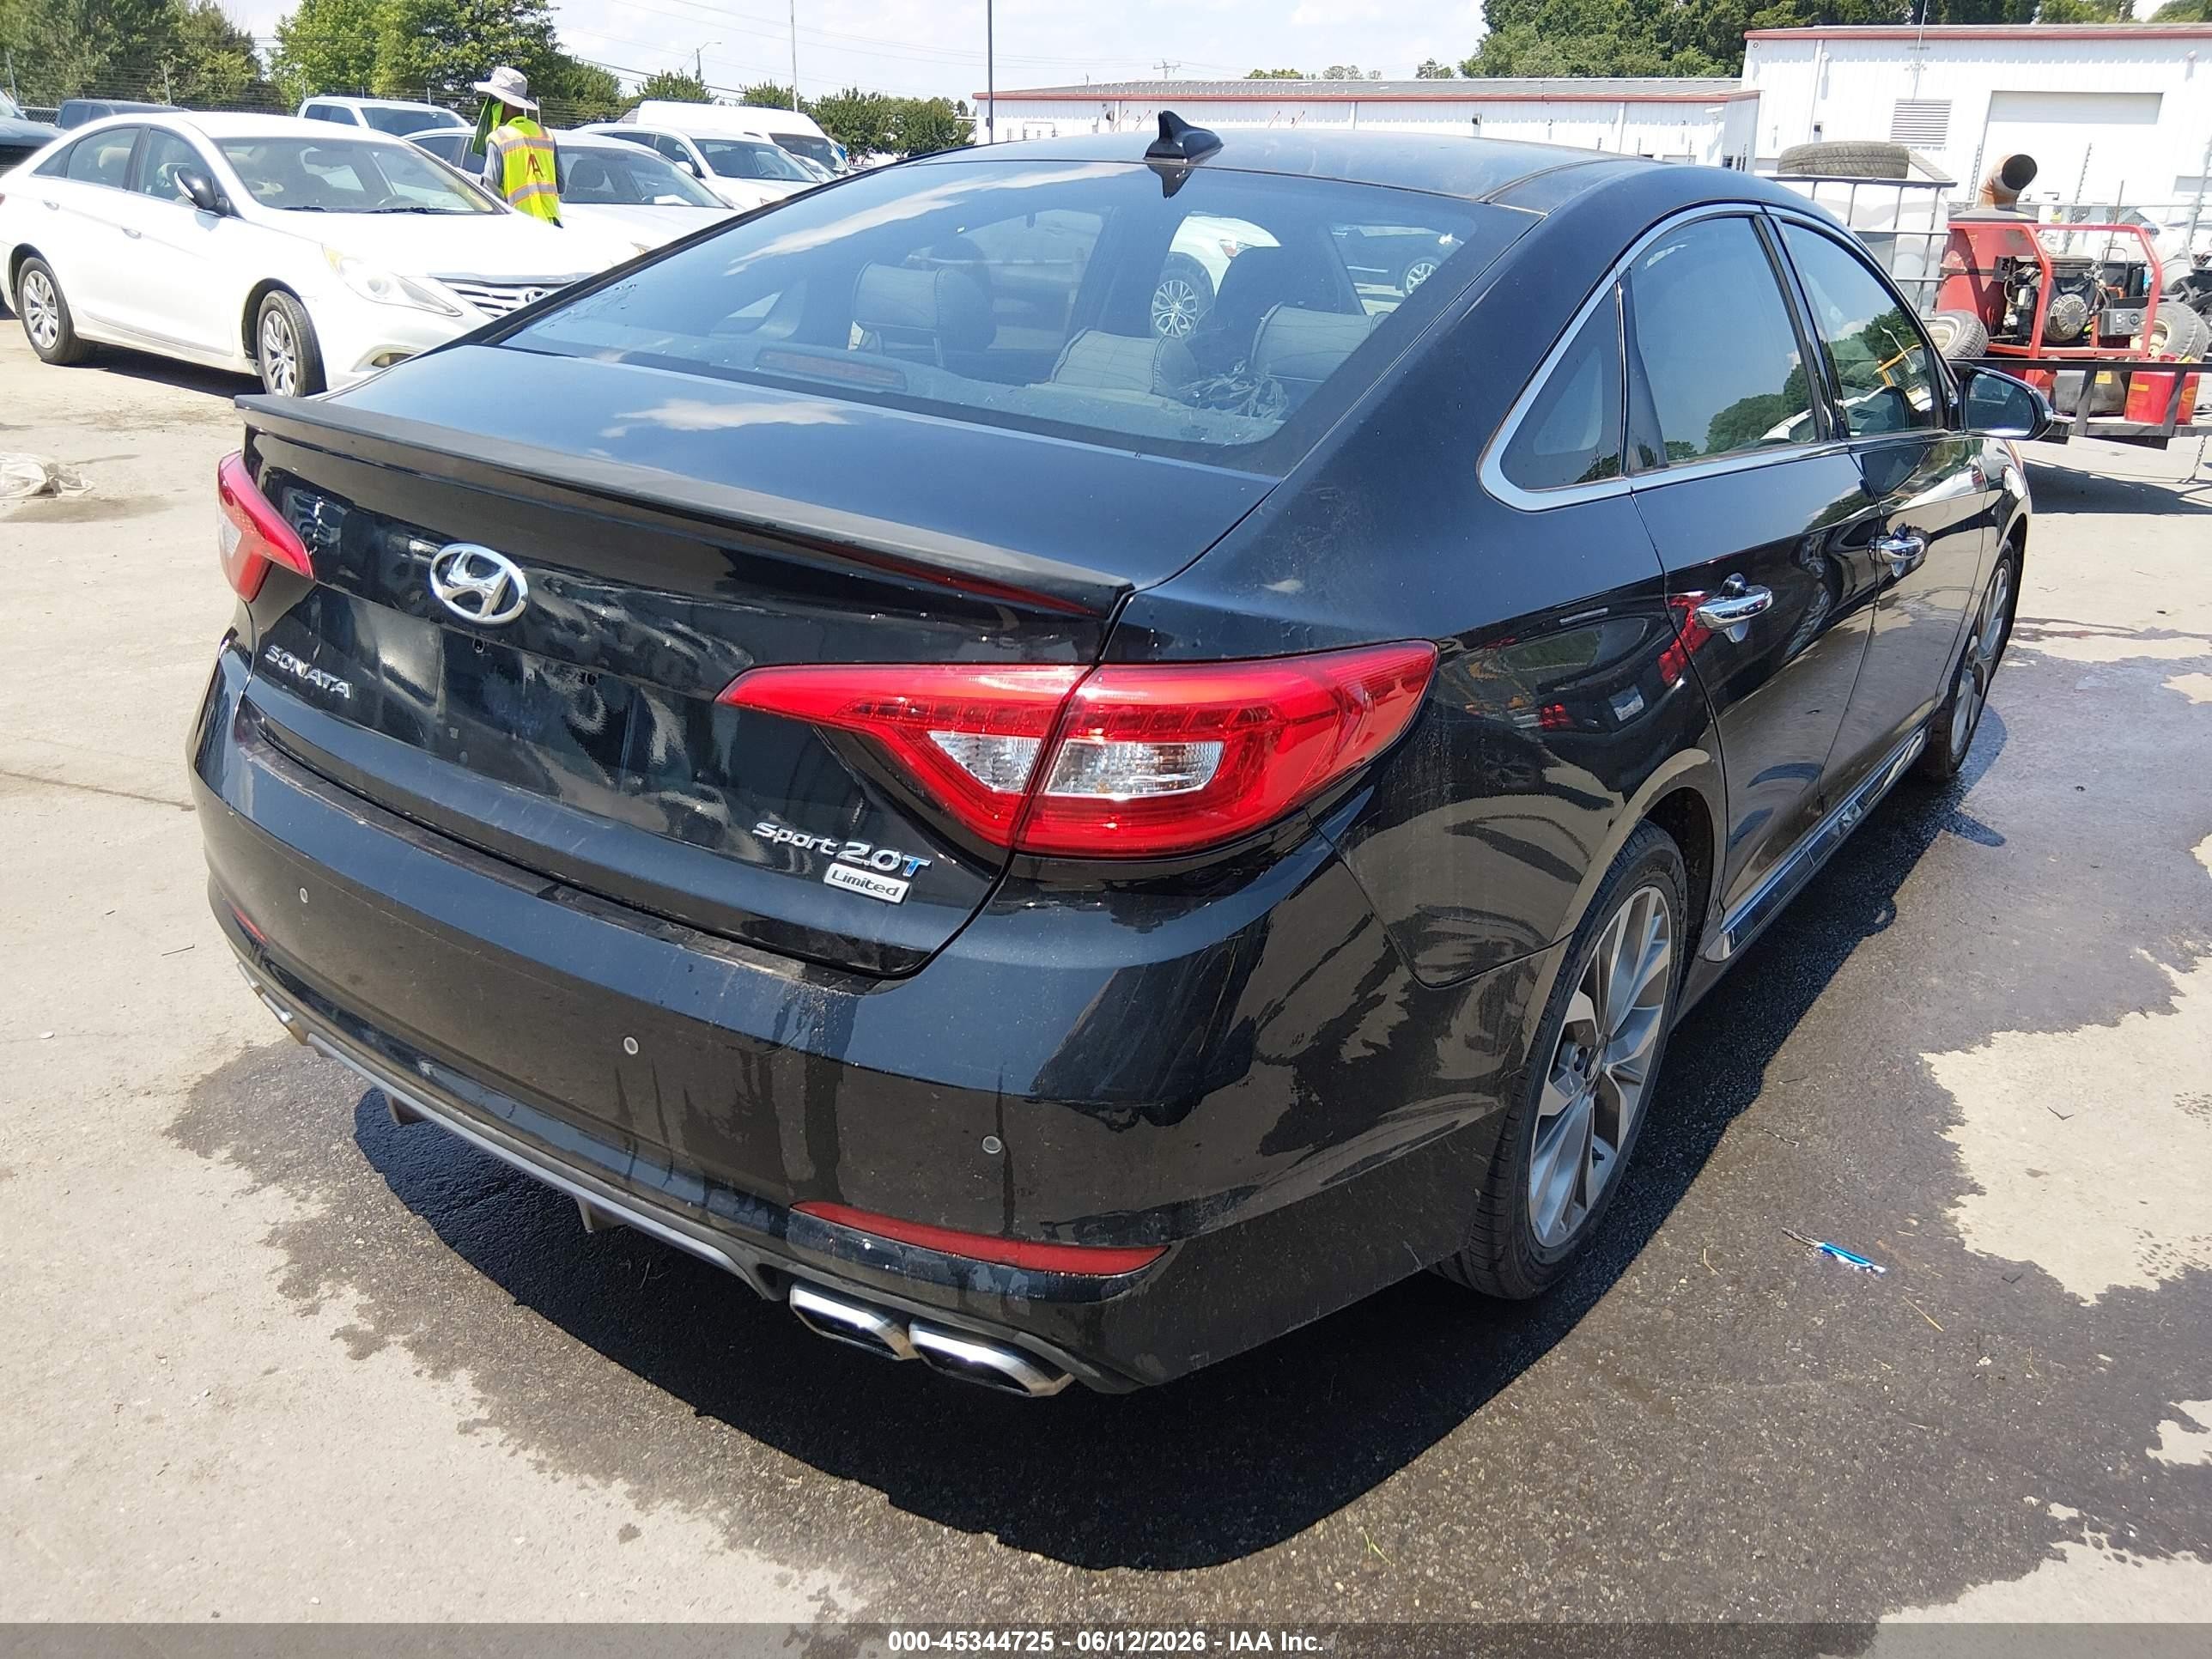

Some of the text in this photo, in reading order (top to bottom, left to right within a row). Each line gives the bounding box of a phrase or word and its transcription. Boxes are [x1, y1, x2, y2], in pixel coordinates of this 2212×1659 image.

[264, 645, 351, 699] SONATA
[752, 822, 932, 878] Sport 2.0T
[831, 869, 900, 896] Limited
